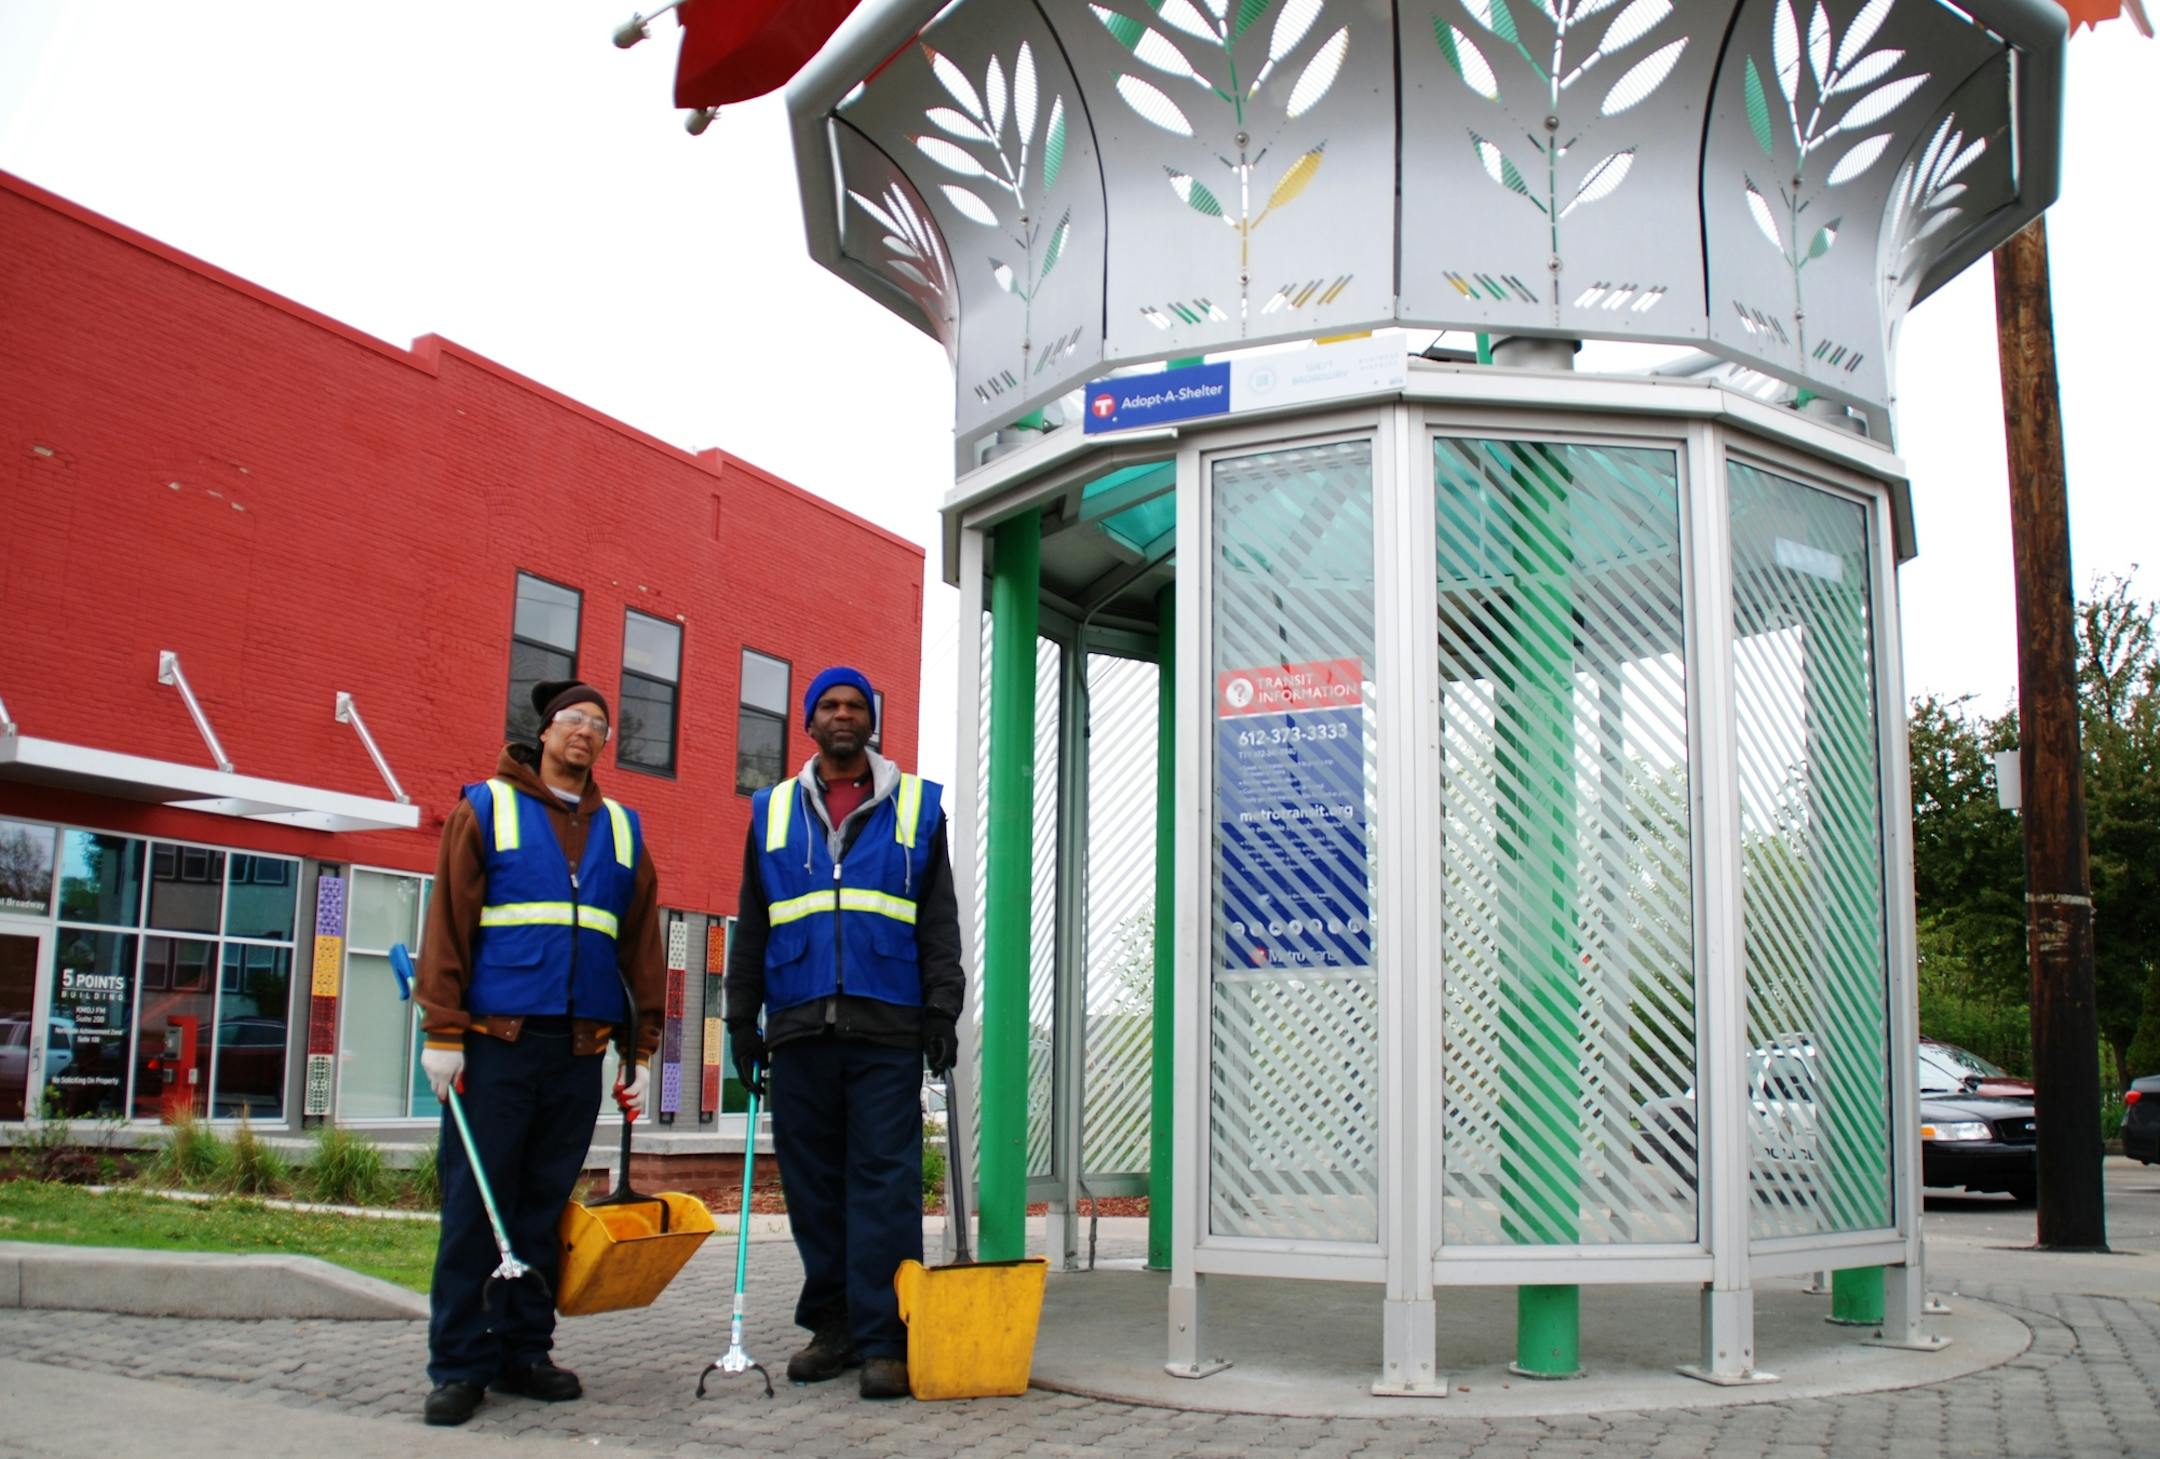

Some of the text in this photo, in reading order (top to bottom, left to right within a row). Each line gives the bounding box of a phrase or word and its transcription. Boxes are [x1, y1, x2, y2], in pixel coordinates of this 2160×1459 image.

[1121, 384, 1223, 409] Adopt-A-Shelter
[1257, 673, 1313, 689] TRANSIT
[1258, 684, 1358, 703] INFORMATION
[1238, 723, 1348, 746] 612-373-3333
[7, 897, 46, 911] Broadway
[62, 968, 125, 990] 5 POINTS
[61, 991, 124, 1001] BUILDING
